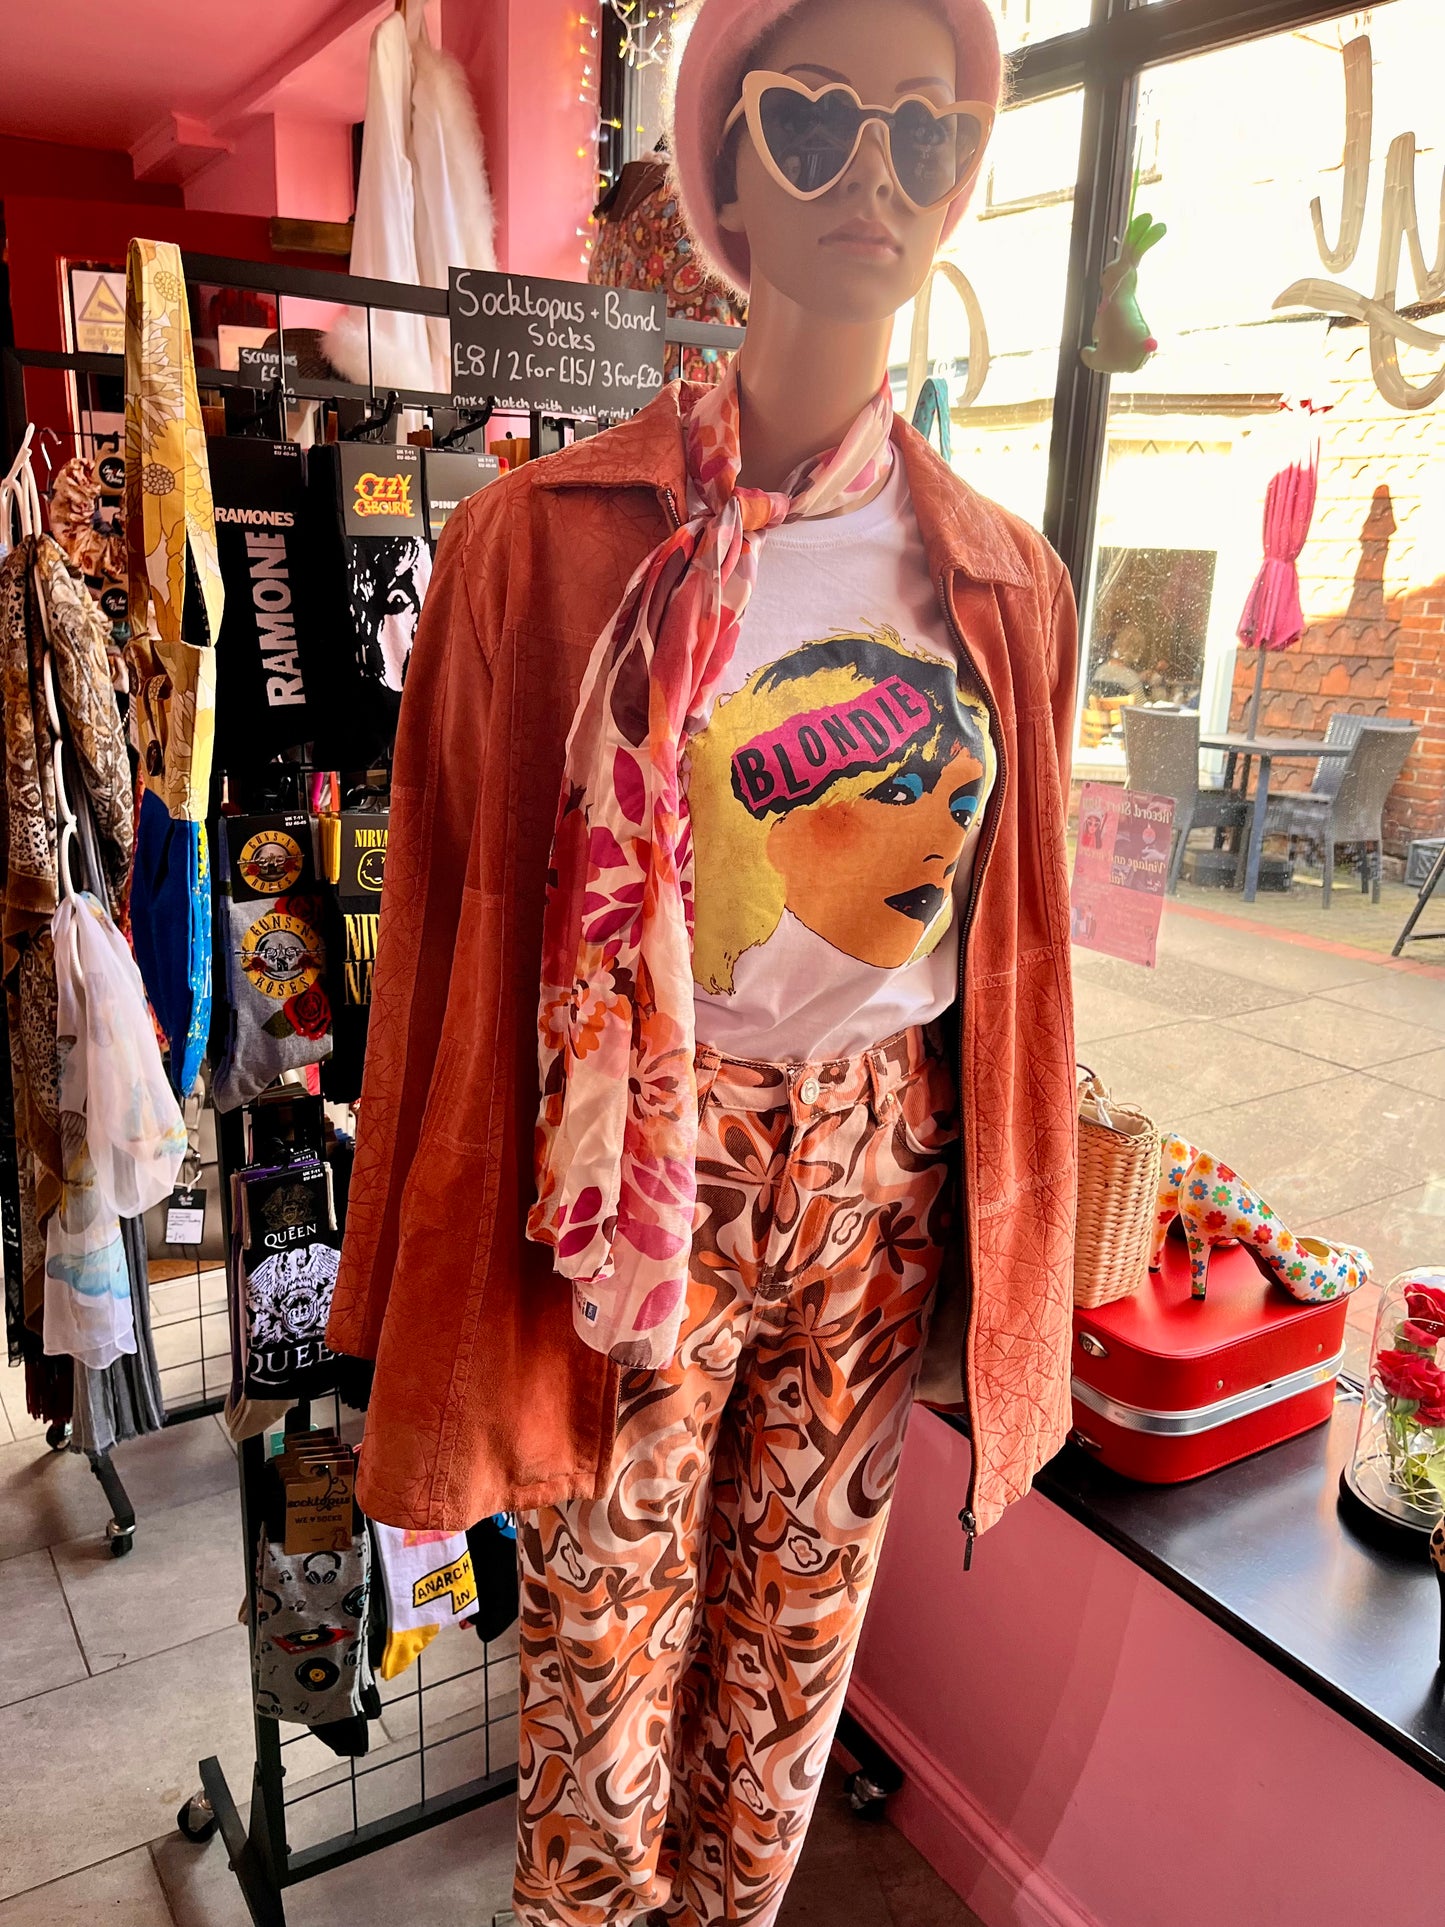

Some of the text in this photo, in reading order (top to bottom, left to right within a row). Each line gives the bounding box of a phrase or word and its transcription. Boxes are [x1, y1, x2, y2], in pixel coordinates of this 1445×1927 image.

[456, 272, 585, 329] Socktopus
[605, 291, 661, 332] Band
[528, 323, 596, 352] Socks
[534, 398, 563, 411] with
[214, 507, 295, 527] RAMONES
[737, 682, 923, 802] BLONDIE
[255, 976, 310, 996] ROSES
[264, 1223, 317, 1249] QUEEN
[247, 1342, 343, 1385] QUEE
